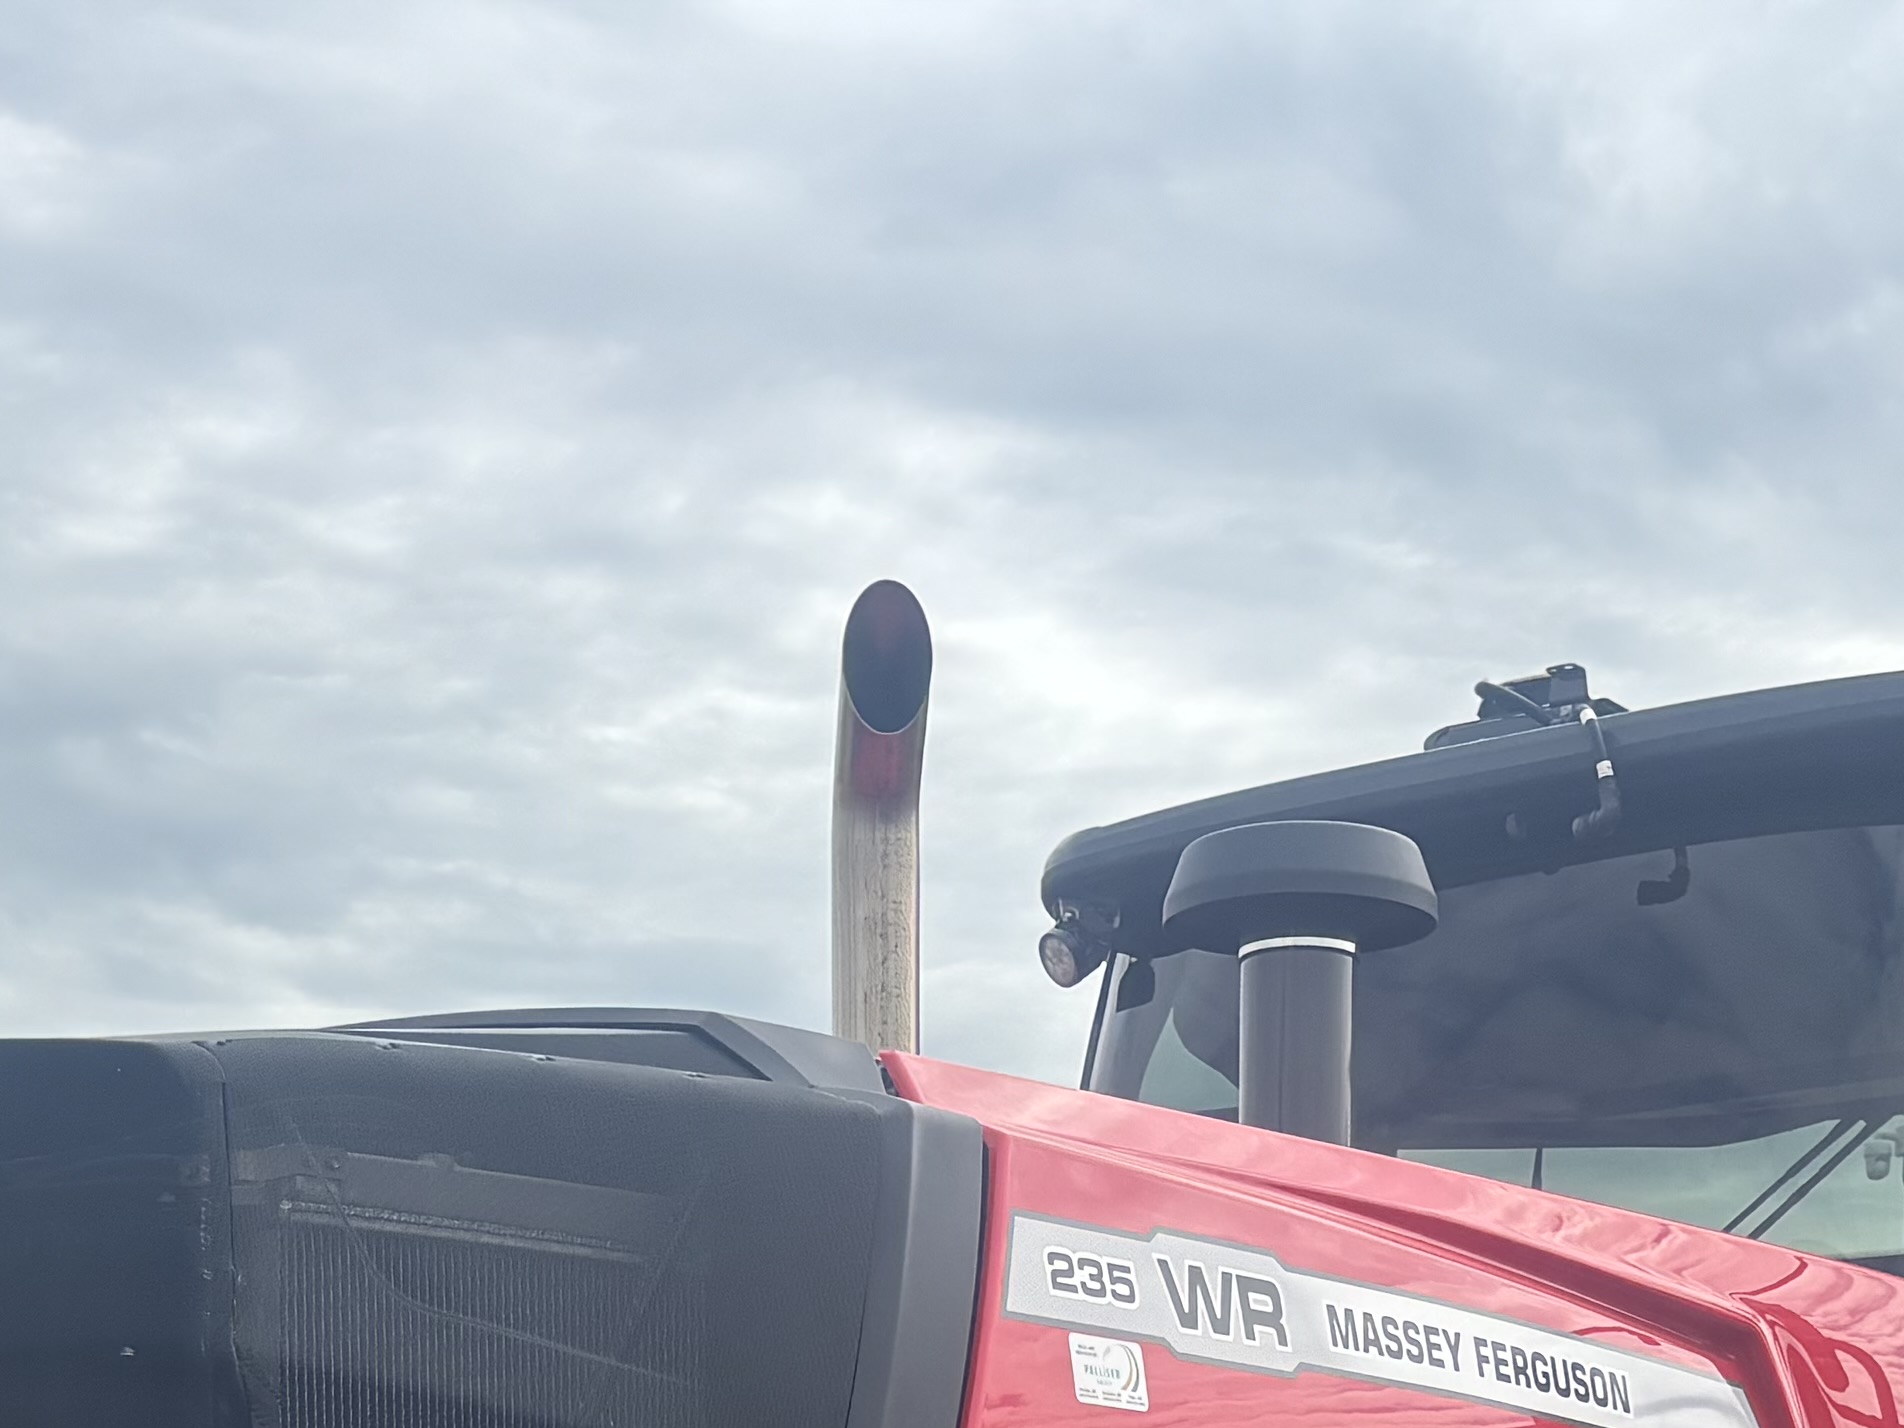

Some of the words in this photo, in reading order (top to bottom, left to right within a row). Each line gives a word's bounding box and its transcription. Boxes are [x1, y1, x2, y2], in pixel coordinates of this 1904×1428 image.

[1045, 1249, 1138, 1306] 235
[1154, 1255, 1290, 1350] WR
[1326, 1304, 1460, 1372] MASSEY
[1473, 1336, 1631, 1414] FERGUSON
